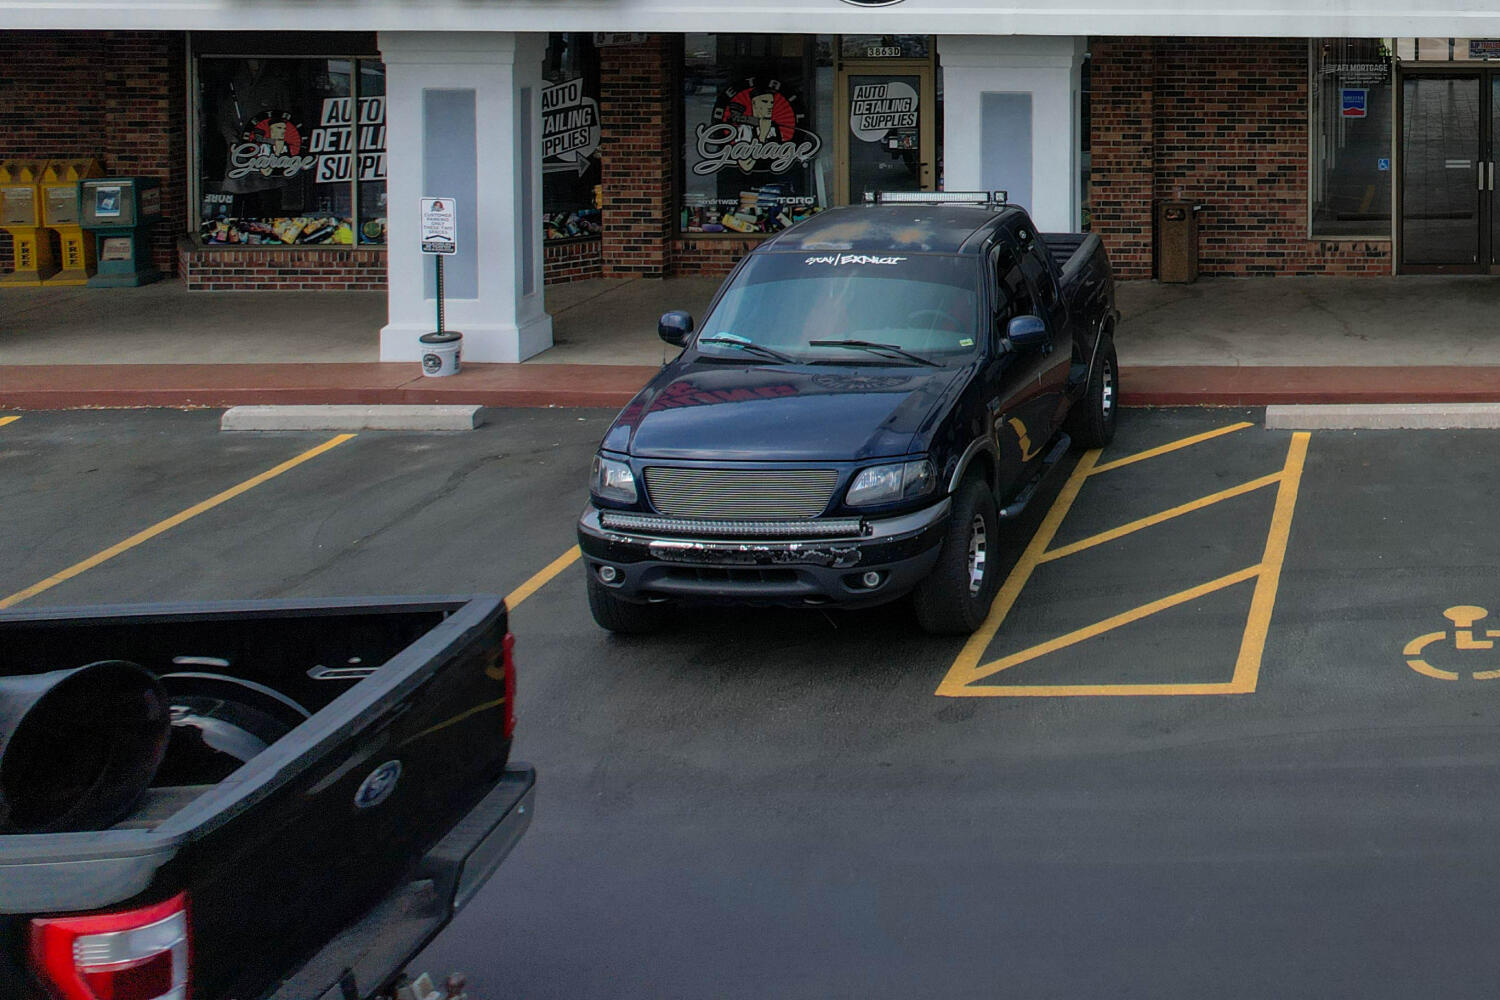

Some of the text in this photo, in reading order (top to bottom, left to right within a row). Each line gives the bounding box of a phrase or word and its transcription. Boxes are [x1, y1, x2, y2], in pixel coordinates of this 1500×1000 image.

[868, 47, 900, 56] 3863D
[1350, 64, 1388, 72] MORTGAGE
[542, 83, 577, 110] AUTO
[856, 85, 886, 99] AUTO
[855, 98, 911, 115] DETAILING
[863, 113, 915, 128] SUPPLIES
[542, 129, 588, 156] PPLIES
[693, 123, 822, 175] Garage
[228, 142, 319, 178] Garage
[777, 196, 814, 205] TORQ
